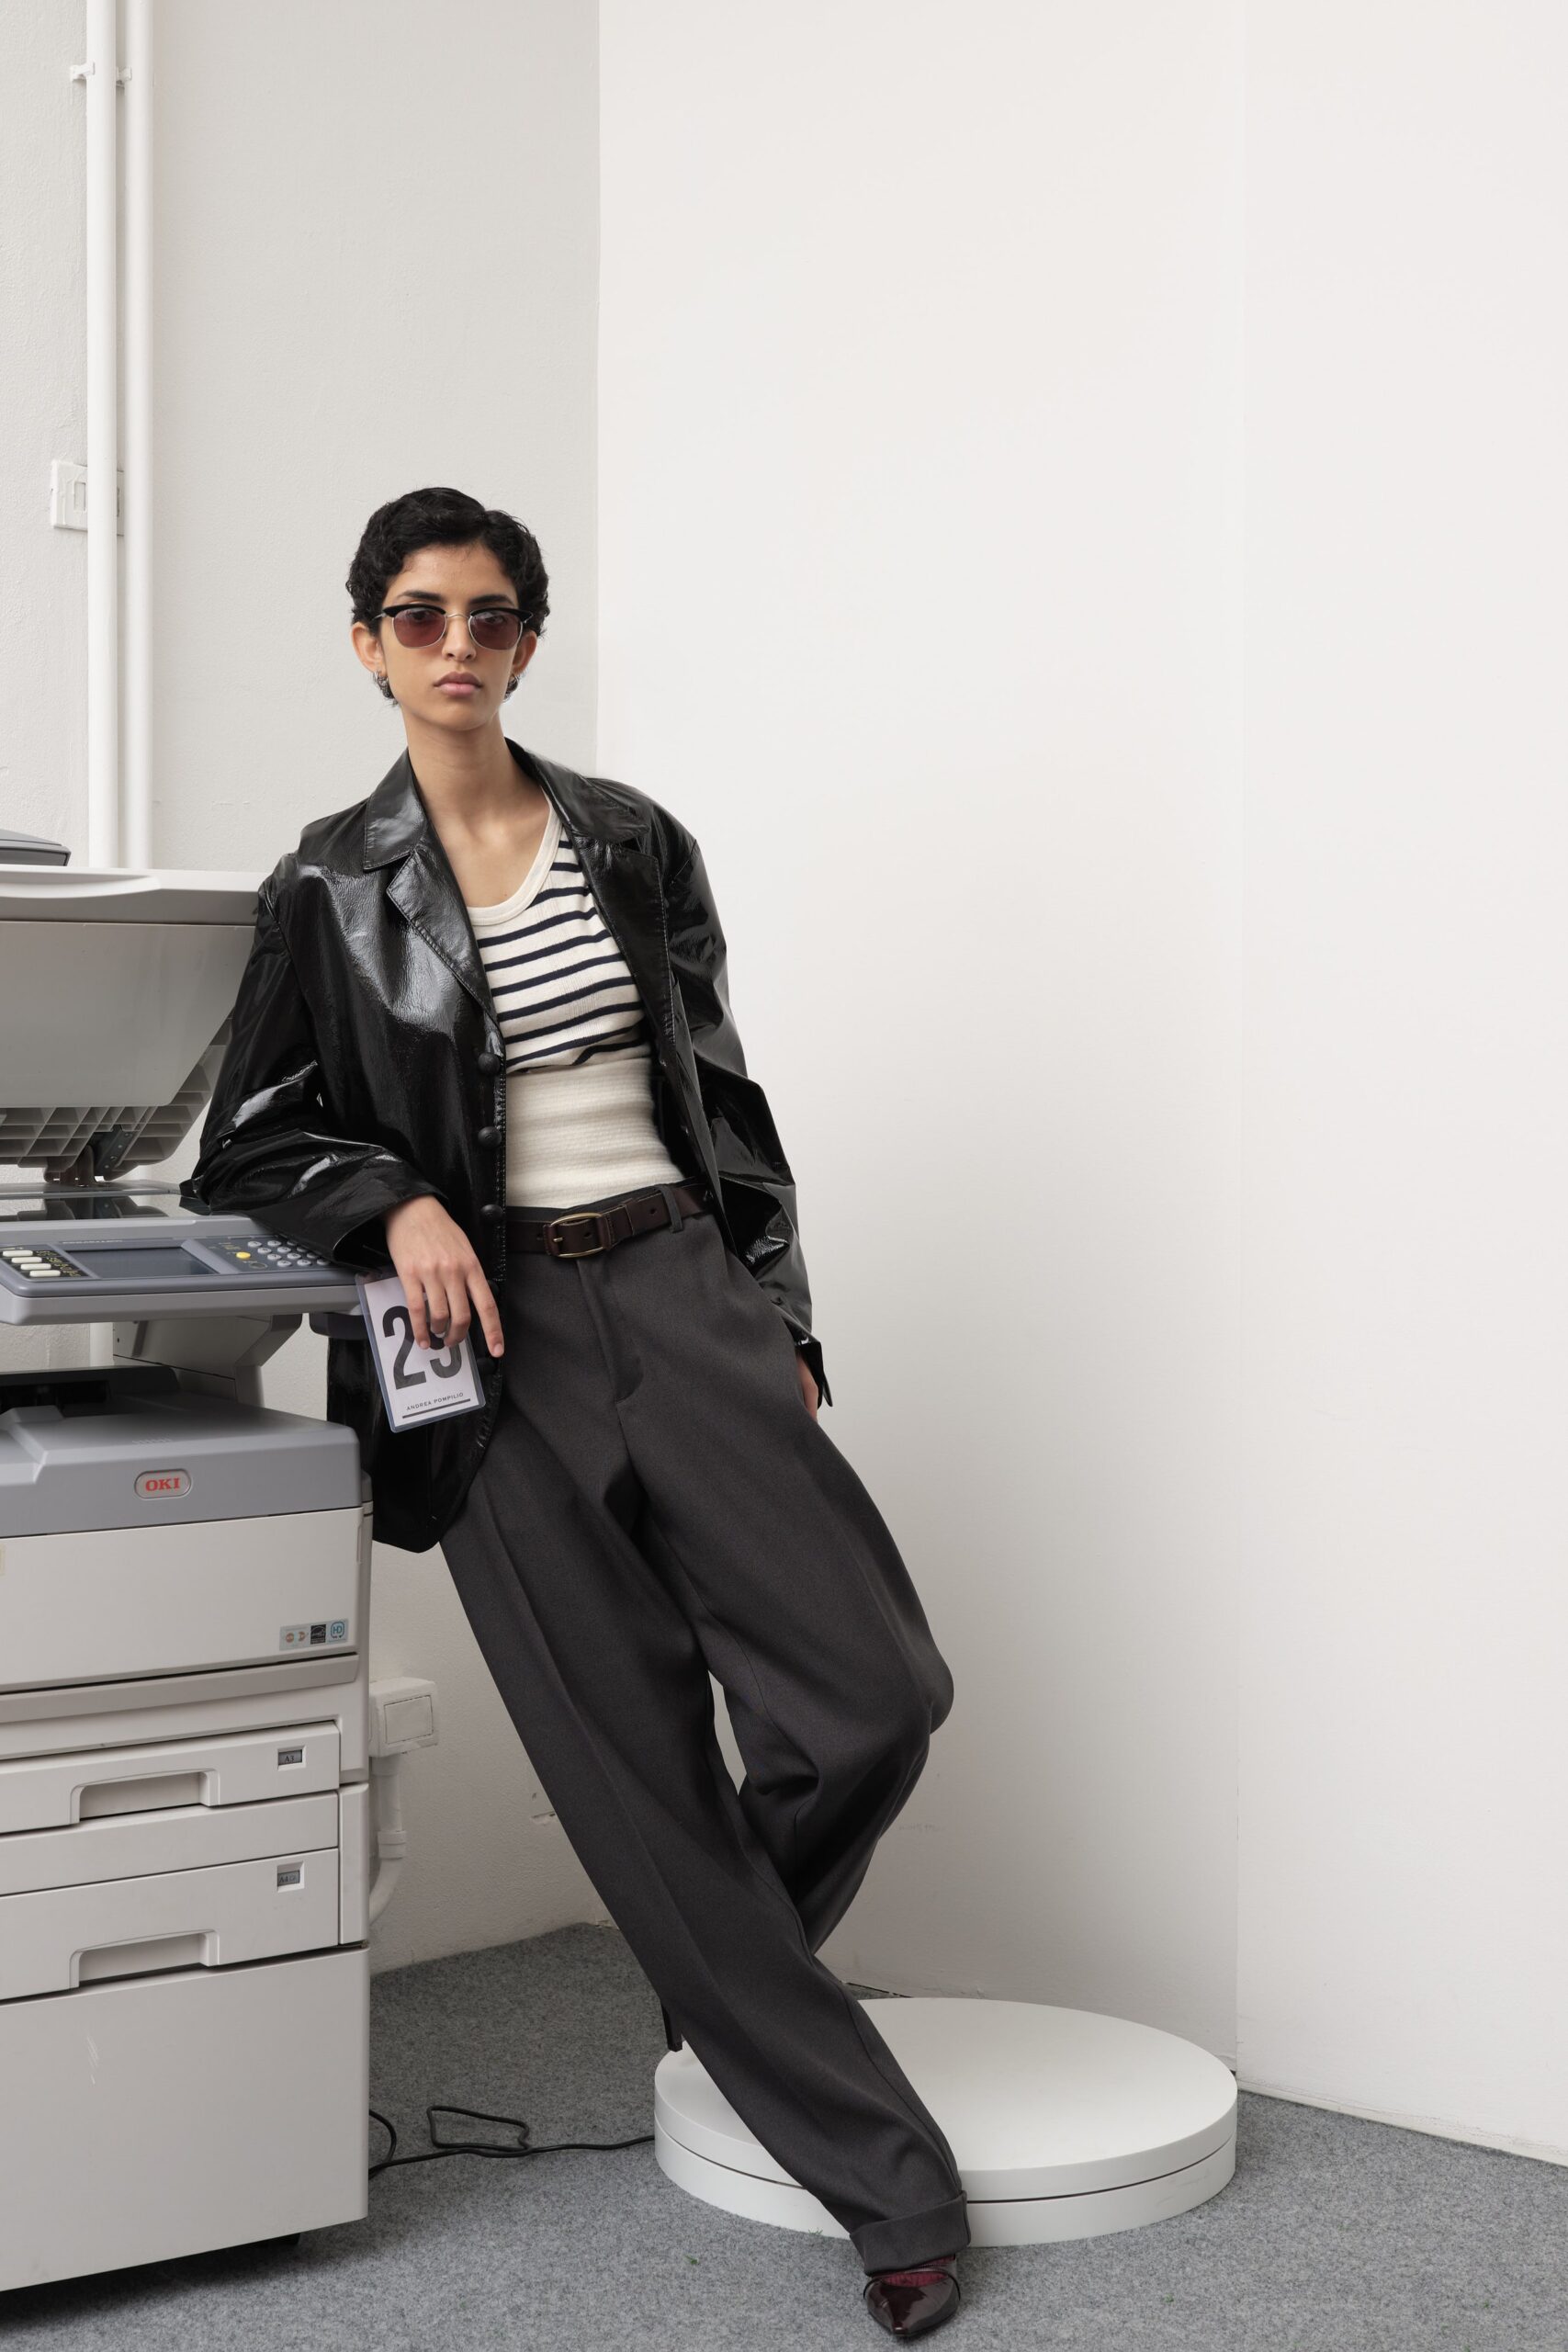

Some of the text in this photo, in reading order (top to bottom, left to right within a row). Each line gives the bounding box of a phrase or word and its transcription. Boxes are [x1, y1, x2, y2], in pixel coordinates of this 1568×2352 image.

[406, 1392, 464, 1411] ANDREA POMPILIO
[145, 1477, 180, 1491] OKI
[285, 1755, 295, 1763] A3
